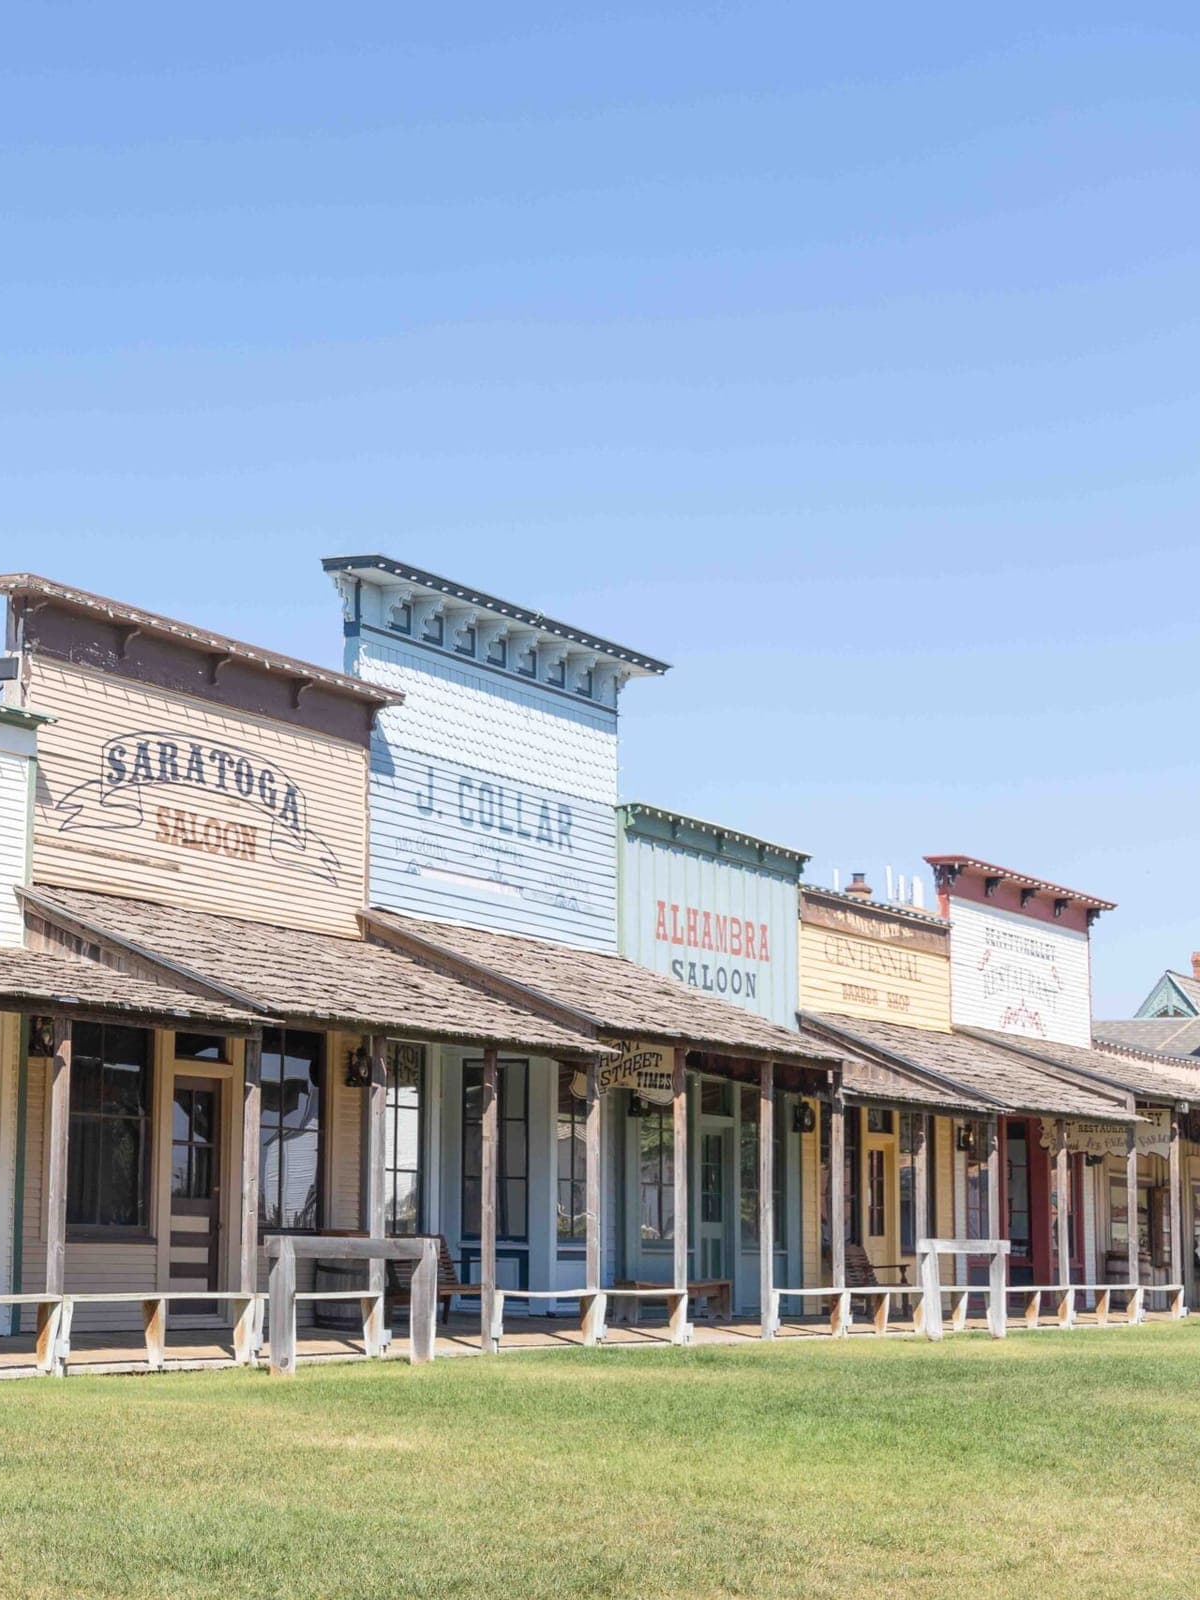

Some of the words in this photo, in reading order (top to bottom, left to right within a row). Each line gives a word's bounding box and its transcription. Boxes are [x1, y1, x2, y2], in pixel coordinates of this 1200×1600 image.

[105, 739, 308, 832] SARATOGA
[154, 805, 258, 862] SALOON
[457, 775, 575, 855] COLLAR
[655, 899, 771, 963] ALHAMBRA
[671, 959, 757, 1000] SALOON
[824, 933, 923, 984] CENTENNIAL
[841, 981, 879, 1006] BARBER
[887, 990, 911, 1012] SHOP
[600, 1051, 663, 1087] STREET
[636, 1070, 673, 1090] TIMES
